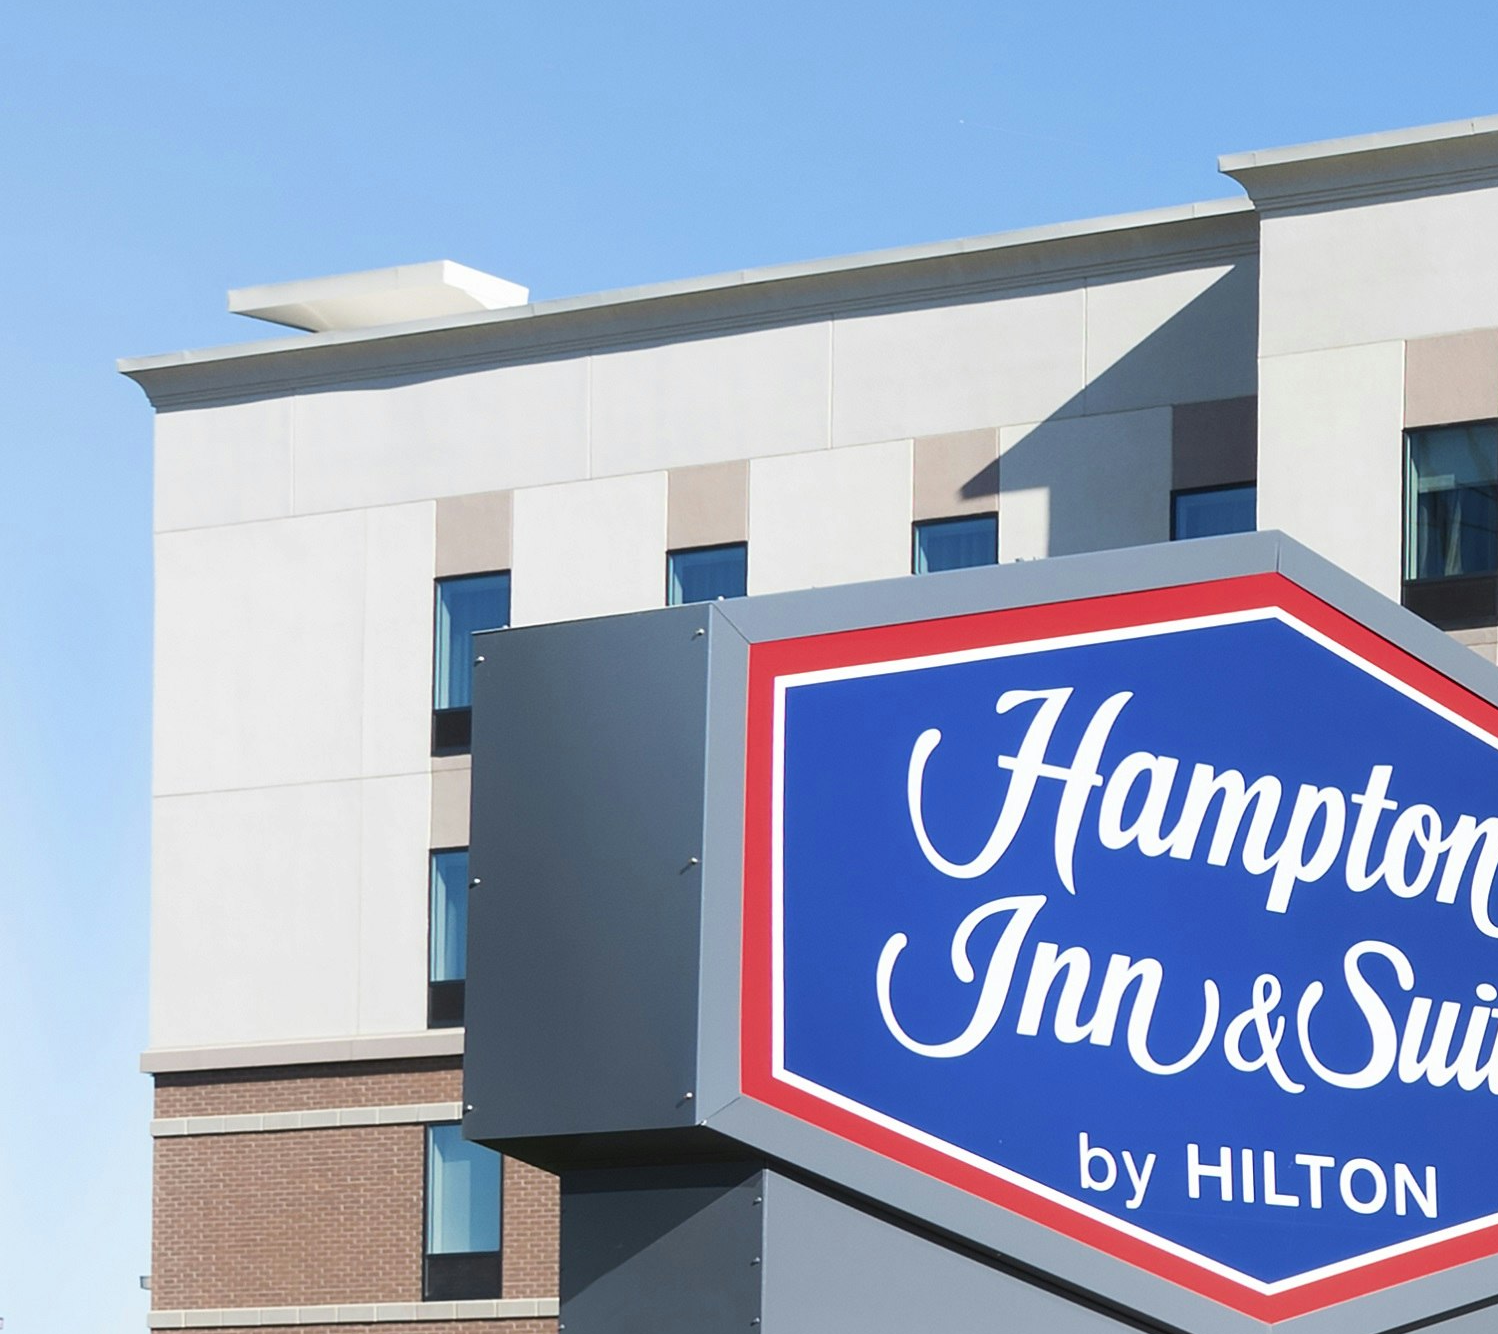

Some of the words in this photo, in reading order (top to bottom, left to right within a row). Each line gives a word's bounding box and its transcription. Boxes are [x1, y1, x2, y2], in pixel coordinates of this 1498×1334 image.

[876, 894, 1221, 1076] Inn
[1223, 973, 1306, 1094] &
[1078, 1131, 1158, 1210] by
[1186, 1143, 1439, 1219] HILTON
